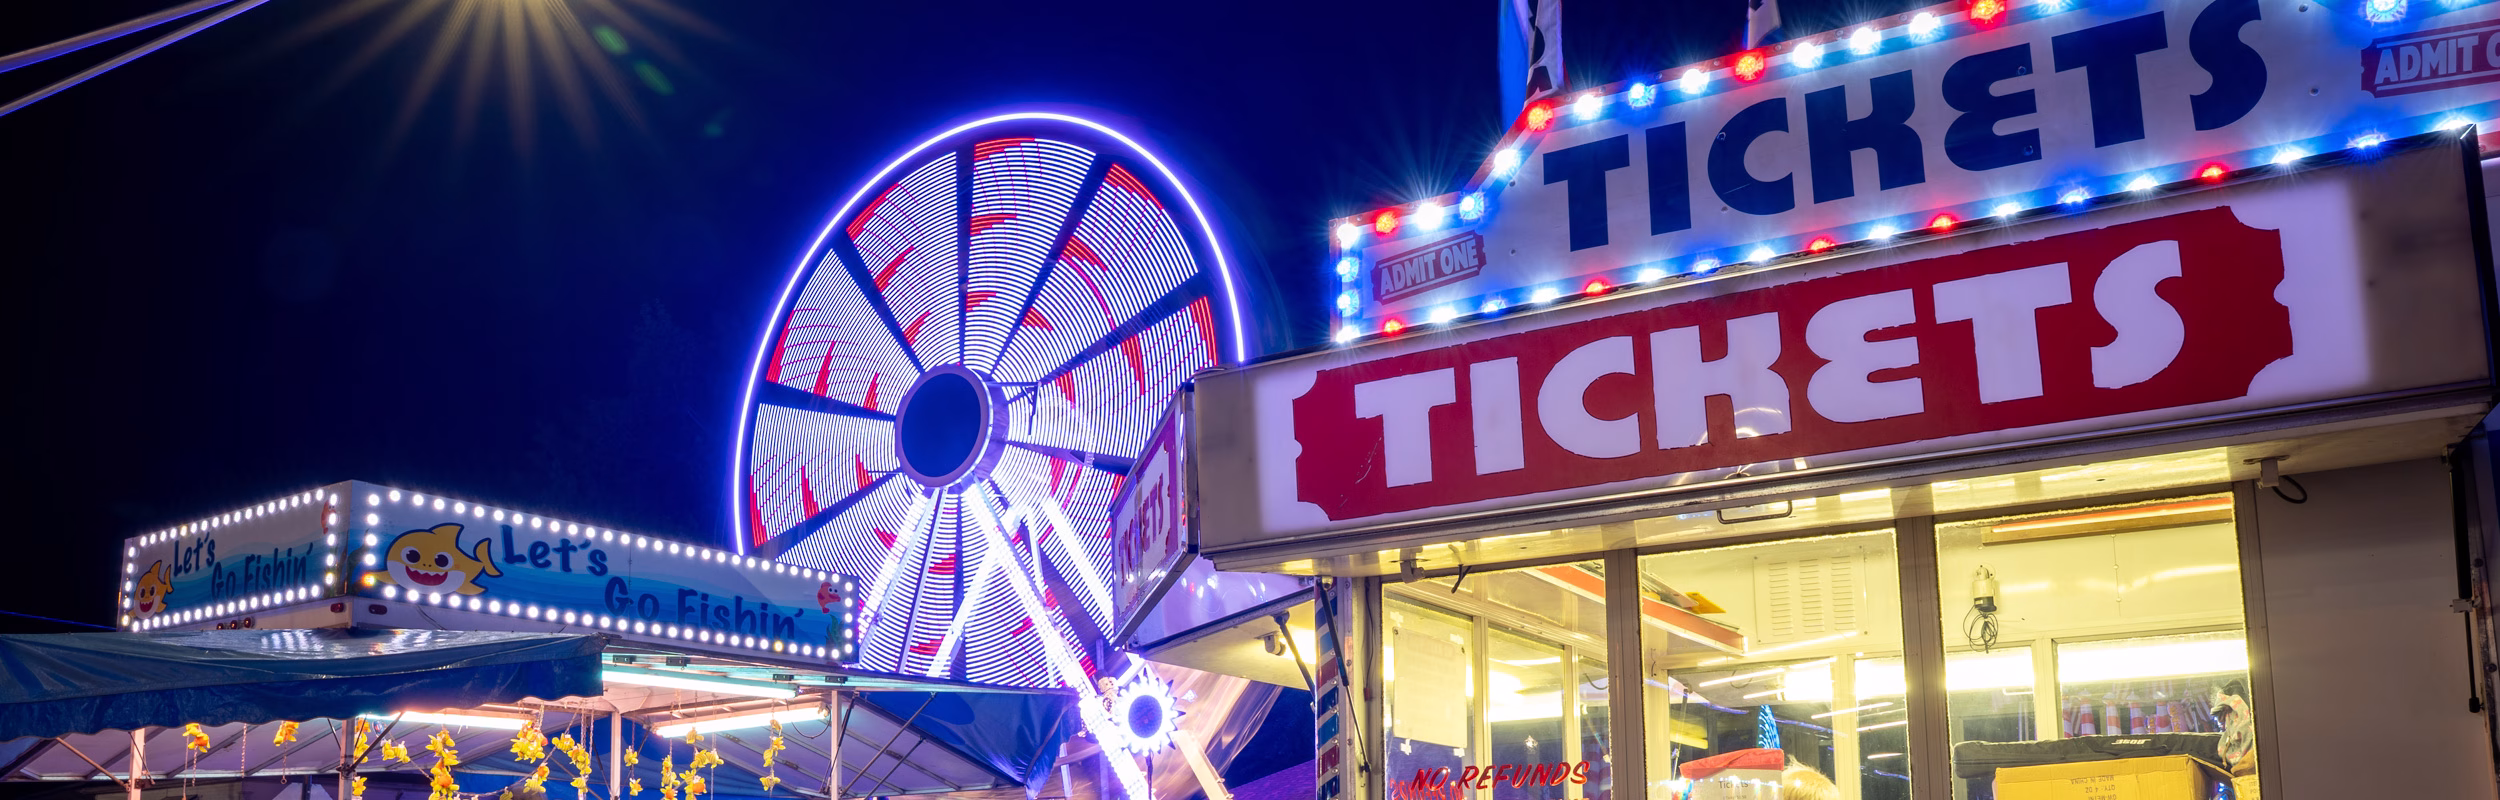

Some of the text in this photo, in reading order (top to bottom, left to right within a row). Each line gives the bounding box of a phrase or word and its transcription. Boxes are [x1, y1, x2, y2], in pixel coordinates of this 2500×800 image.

[2374, 33, 2479, 86] ADMIT
[1543, 0, 2268, 252] TICKETS
[1381, 241, 1478, 295] ADMIT ONE
[1355, 239, 2186, 488] TICKETS
[173, 531, 216, 577] Let's
[500, 524, 608, 577] Let's
[211, 561, 236, 602] Go
[604, 576, 661, 621] Go
[1411, 760, 1591, 791] NO REFUNDS
